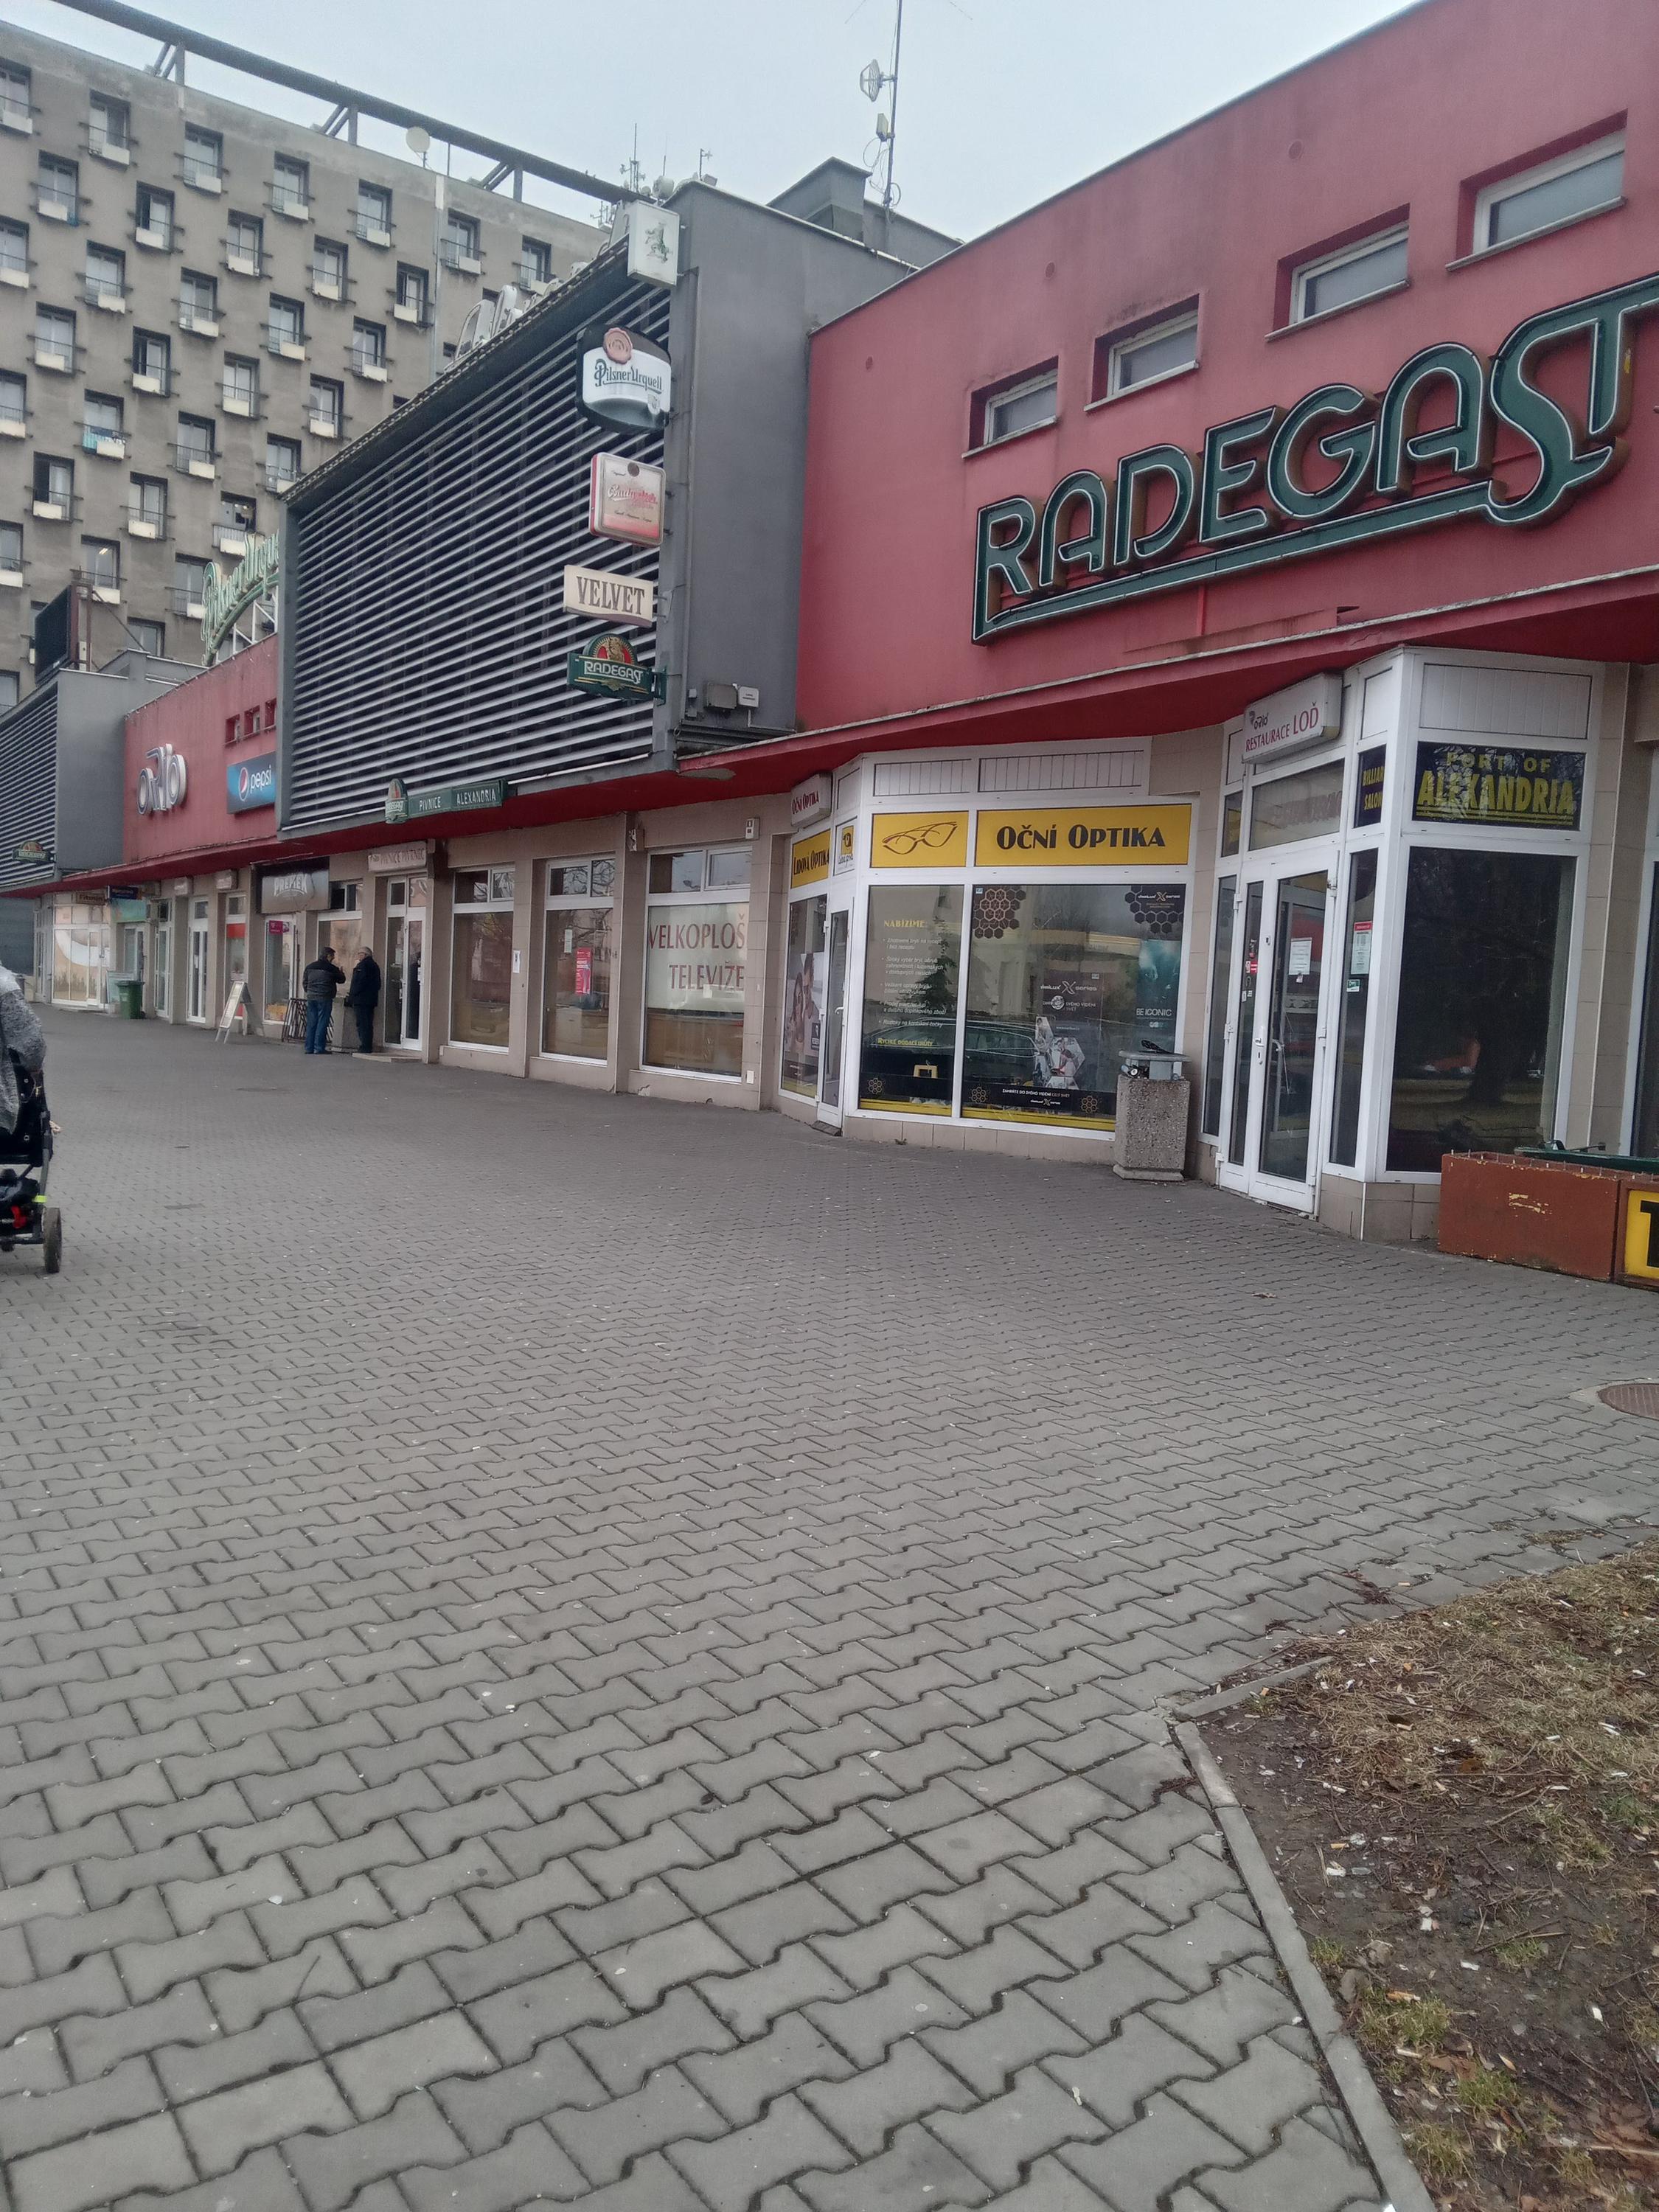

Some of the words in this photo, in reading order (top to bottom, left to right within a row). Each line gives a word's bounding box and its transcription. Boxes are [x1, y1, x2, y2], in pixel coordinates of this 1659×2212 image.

[594, 358, 631, 387] Pilsner
[631, 366, 662, 392] Urquell
[971, 273, 1659, 646] RADEGAST
[576, 576, 644, 615] VELVET
[584, 661, 644, 685] RADEGAST
[1245, 723, 1290, 752] RESTAURACE
[1293, 701, 1319, 735] LOĎ
[1447, 751, 1505, 771] PORT
[1523, 757, 1551, 773] OF
[250, 764, 272, 794] pepsi
[1416, 769, 1574, 815] ALEXANDRIA
[419, 796, 442, 812] PIVNICE
[456, 788, 497, 806] ALEXANDRIA
[803, 790, 819, 810] OPTIKA
[996, 824, 1057, 850] OČNÍ
[1068, 824, 1166, 849] OPTIKA
[810, 848, 830, 870] OPTIKA
[648, 914, 745, 949] VELKOPLOŠ
[1145, 1008, 1172, 1017] ICONIC
